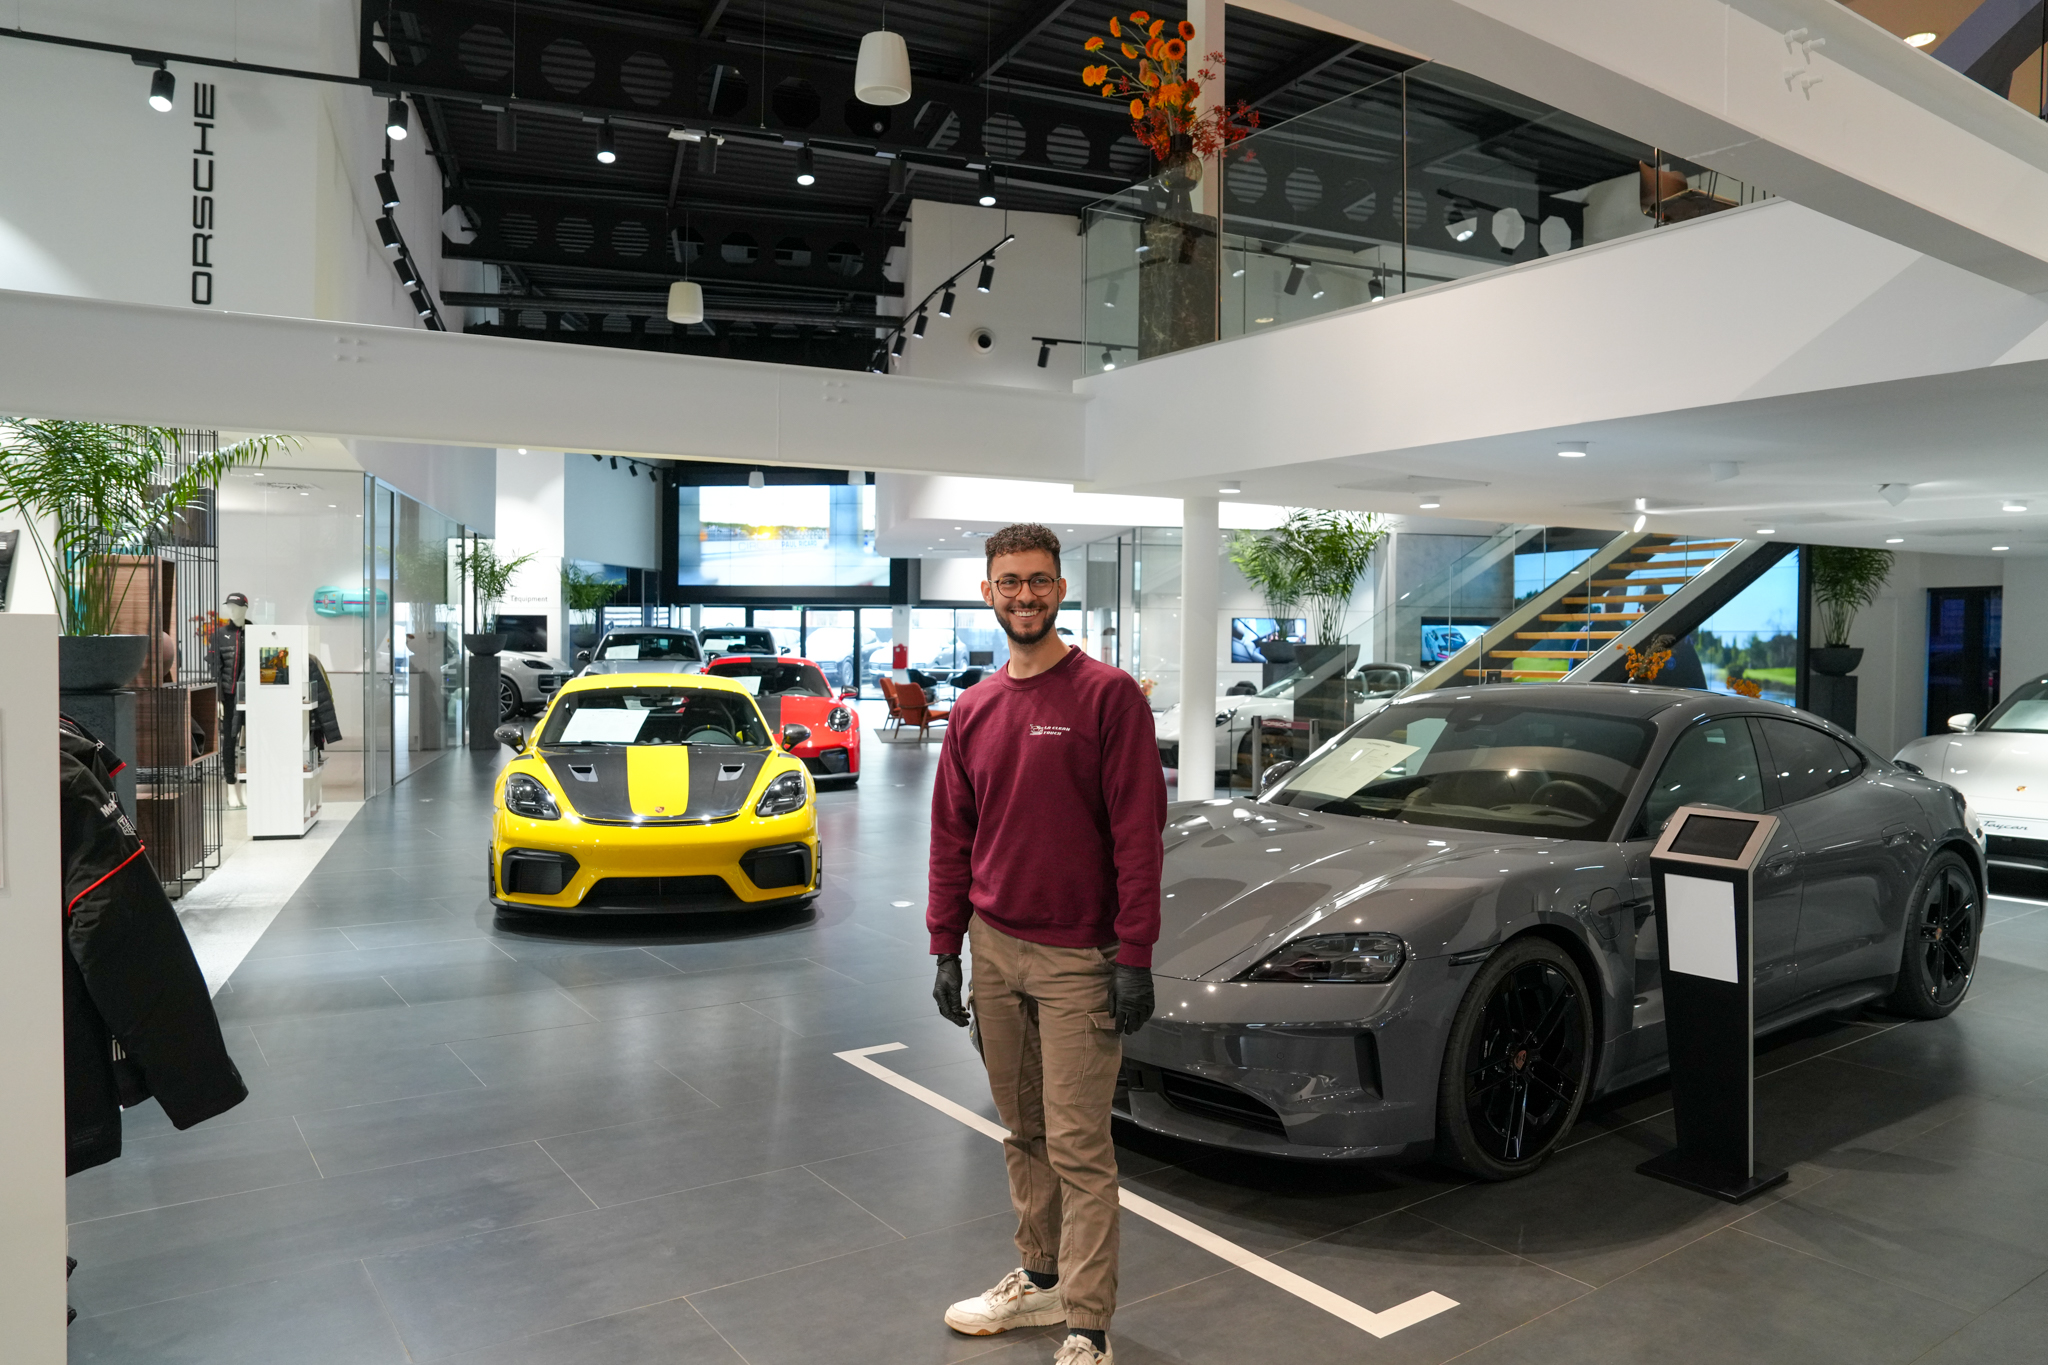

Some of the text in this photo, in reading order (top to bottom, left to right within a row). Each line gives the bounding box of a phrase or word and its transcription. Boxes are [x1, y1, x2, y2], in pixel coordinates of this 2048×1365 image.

[192, 82, 215, 305] ORSCHE
[781, 540, 797, 548] PAUL
[511, 595, 548, 603] Tequipment
[1984, 820, 2028, 830] Taycan
